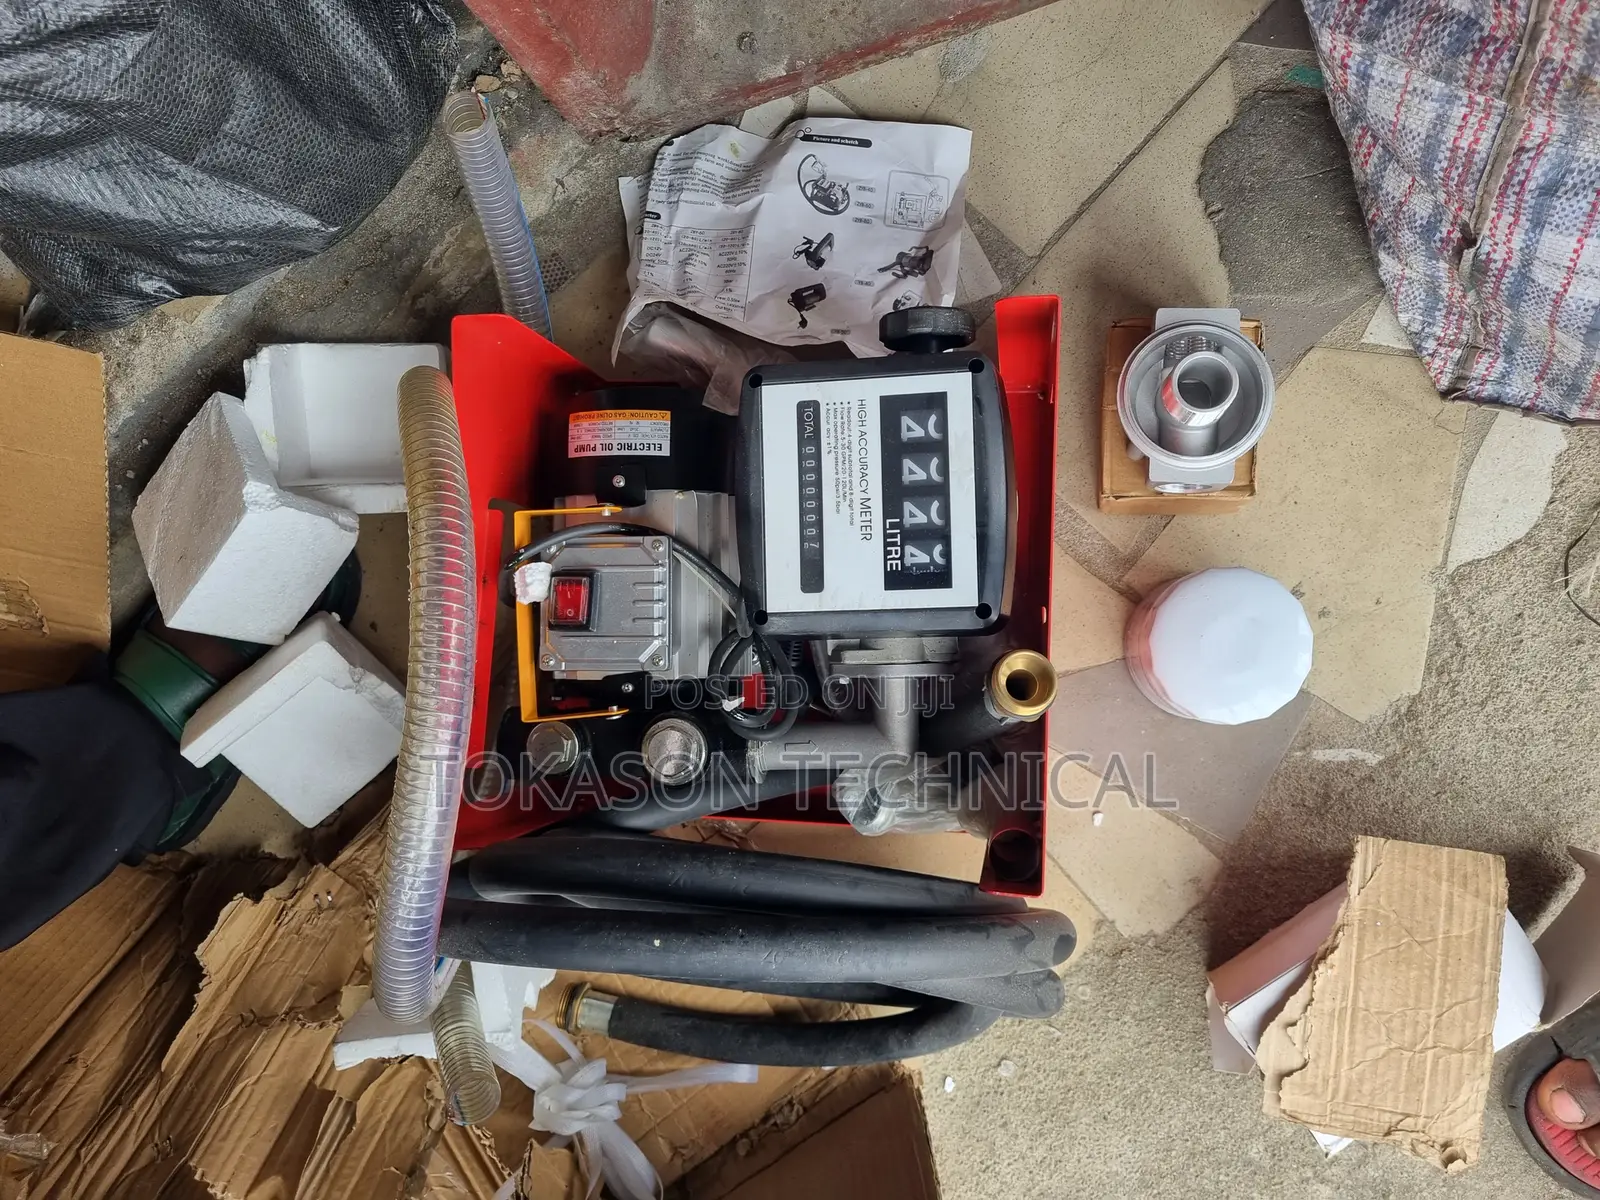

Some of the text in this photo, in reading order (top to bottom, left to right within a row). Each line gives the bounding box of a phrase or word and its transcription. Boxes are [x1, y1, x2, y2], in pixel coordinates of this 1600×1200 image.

[804, 407, 814, 438] TOTAL
[574, 442, 662, 453] ELECTRIC OIL PUMP
[858, 399, 872, 541] HIGH ACCURACY METER
[886, 518, 901, 571] LITRE
